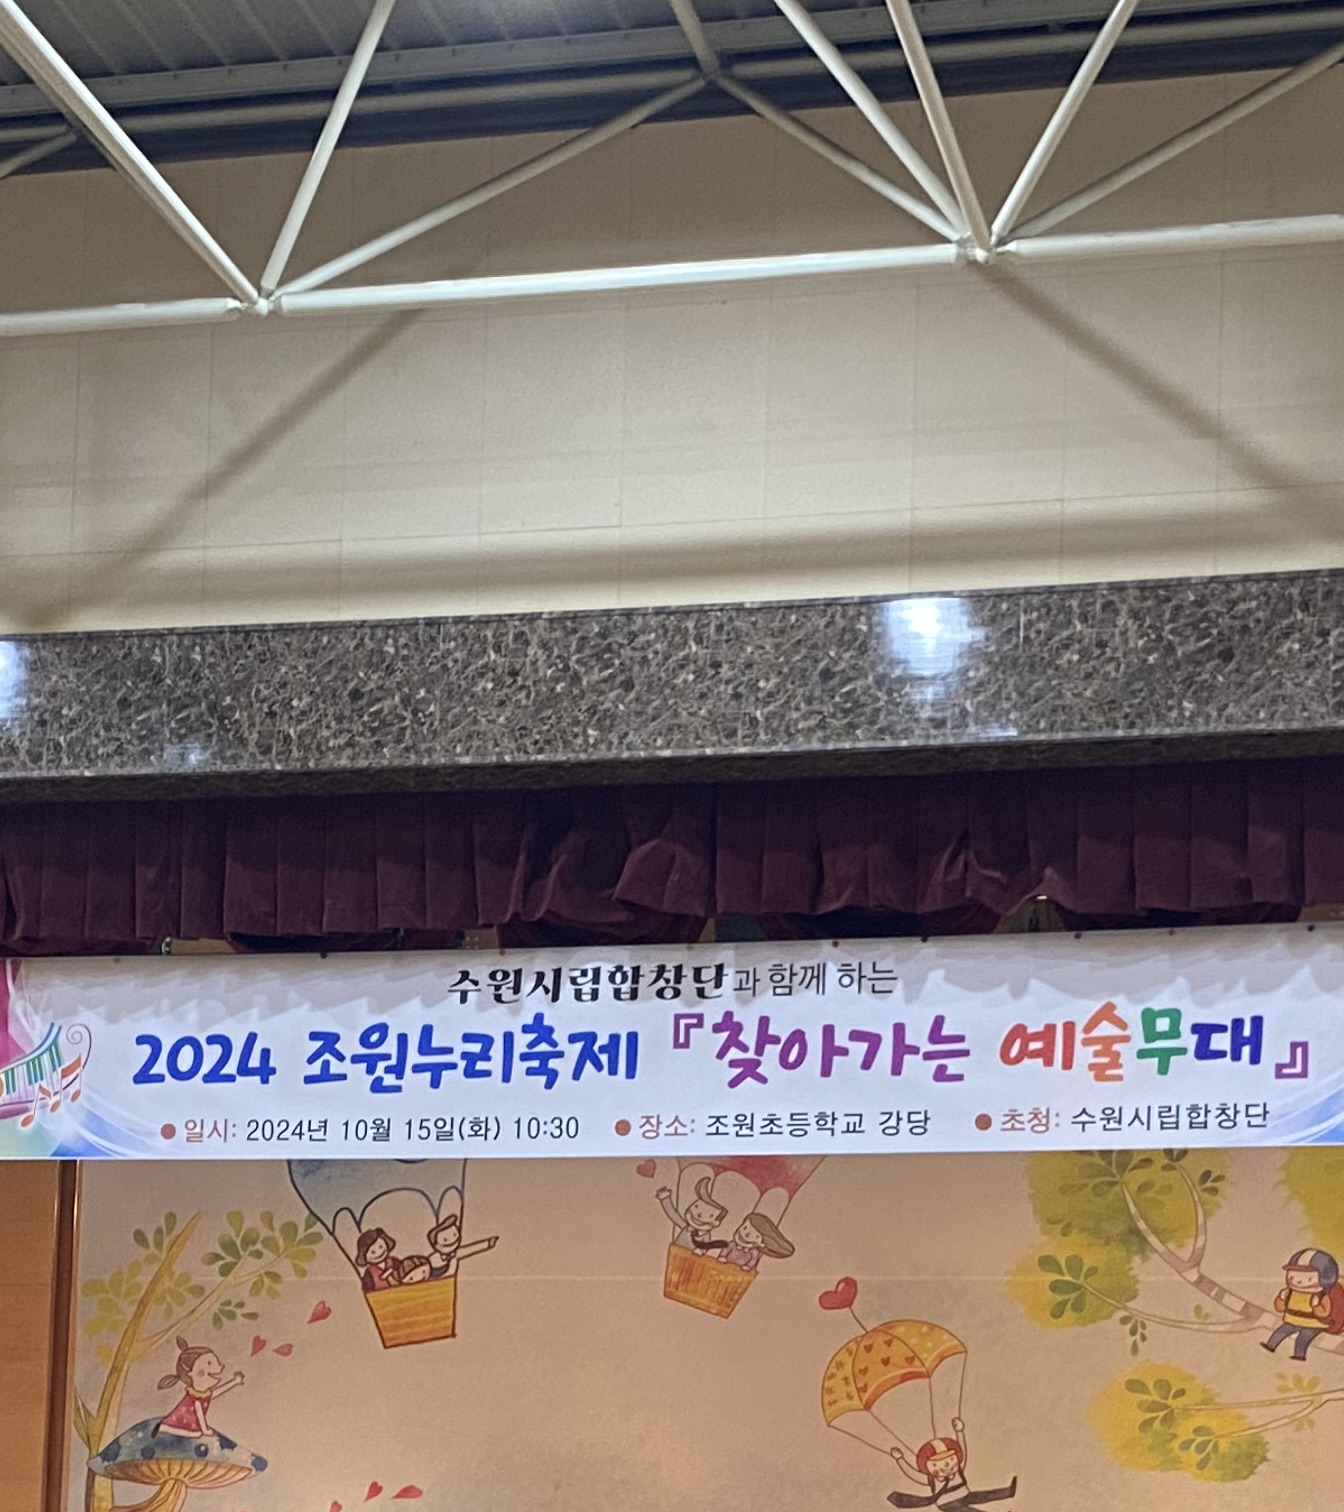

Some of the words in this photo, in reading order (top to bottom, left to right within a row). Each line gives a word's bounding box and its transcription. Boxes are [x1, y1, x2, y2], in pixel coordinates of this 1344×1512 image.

[836, 963, 898, 995] 하는
[132, 1031, 277, 1085] 2024
[302, 1012, 639, 1093] 조원누리축제
[184, 1119, 237, 1144] 일시:
[246, 1116, 328, 1142] 2024년
[341, 1116, 391, 1141] 10월
[404, 1115, 501, 1142] 15일(화)
[513, 1116, 580, 1140] 10:30
[638, 1113, 696, 1139] 장소:
[706, 1110, 866, 1138] 조원초등학교
[878, 1109, 931, 1136] 강당
[1000, 1107, 1060, 1133] 초청:
[1070, 1101, 1271, 1133] 수원시립합창단
